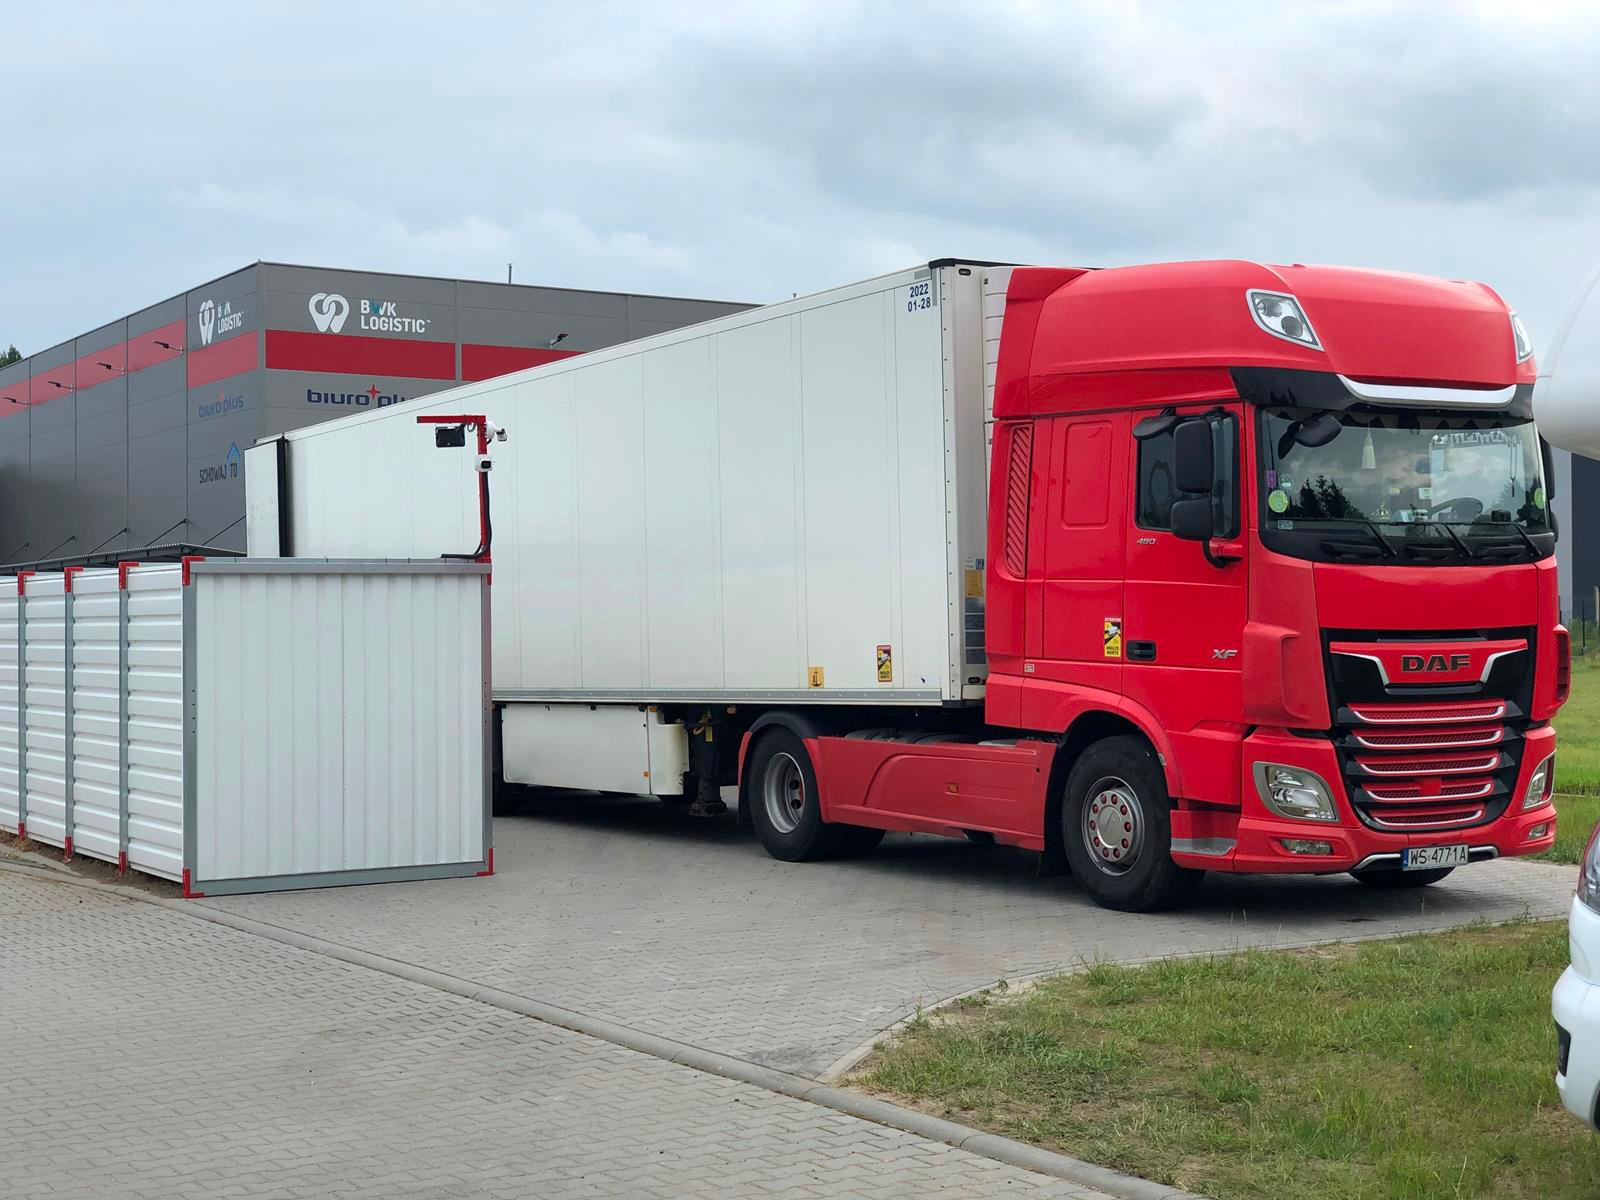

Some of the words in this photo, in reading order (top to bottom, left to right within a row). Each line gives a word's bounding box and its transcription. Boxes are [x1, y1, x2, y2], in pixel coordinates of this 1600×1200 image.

[910, 283, 929, 298] 2022
[908, 297, 931, 312] 01-28
[217, 312, 242, 334] LOGISTIC
[361, 315, 426, 333] LOGISTIC
[307, 389, 370, 406] biuro
[378, 394, 412, 408] pl
[199, 464, 227, 483] SCHOWAJ
[230, 462, 238, 478] TO
[1212, 649, 1238, 659] XF
[1401, 654, 1470, 672] DAF
[1411, 850, 1427, 865] WS
[1431, 846, 1466, 864] 4771A
